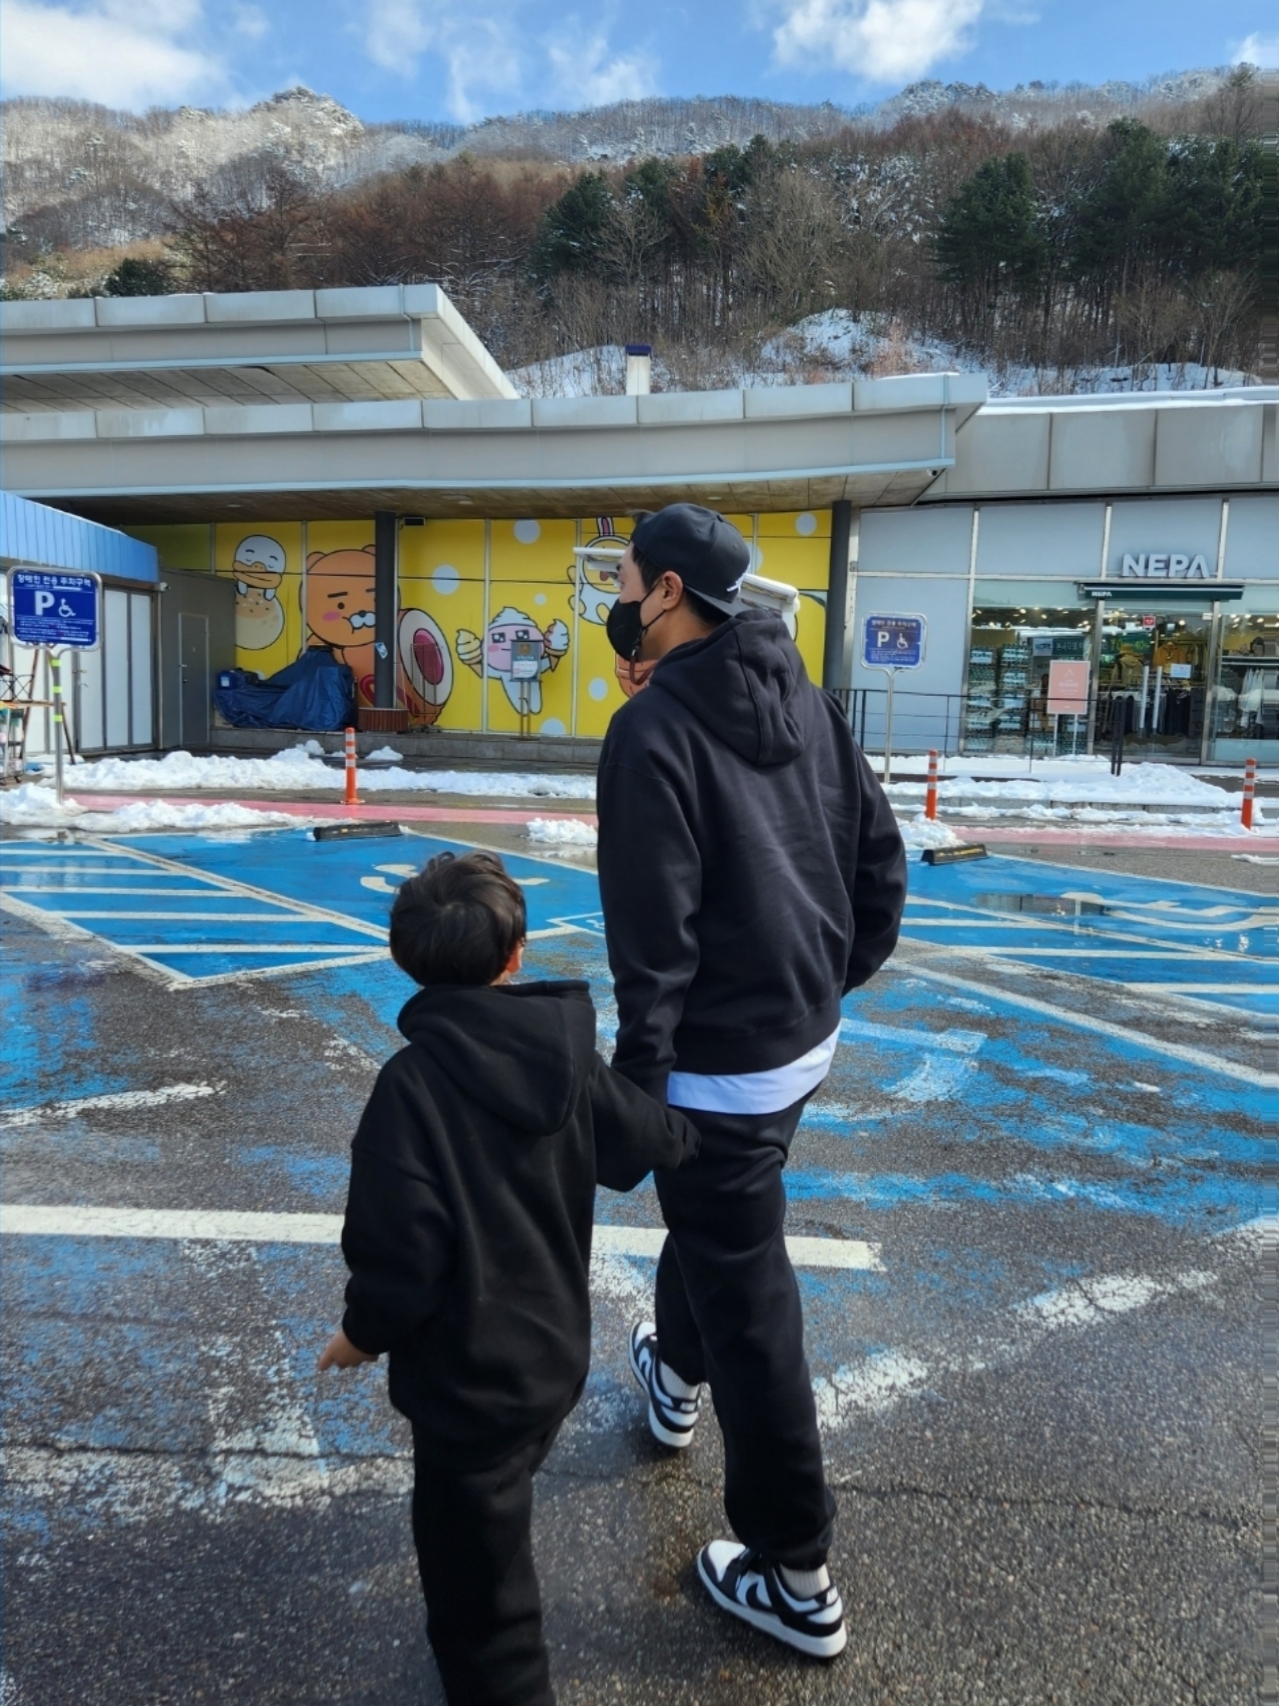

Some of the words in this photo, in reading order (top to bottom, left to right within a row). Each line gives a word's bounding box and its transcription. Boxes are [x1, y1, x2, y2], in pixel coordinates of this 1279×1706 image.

[1122, 553, 1210, 578] NEPA
[35, 590, 55, 616] P
[877, 631, 890, 648] P
